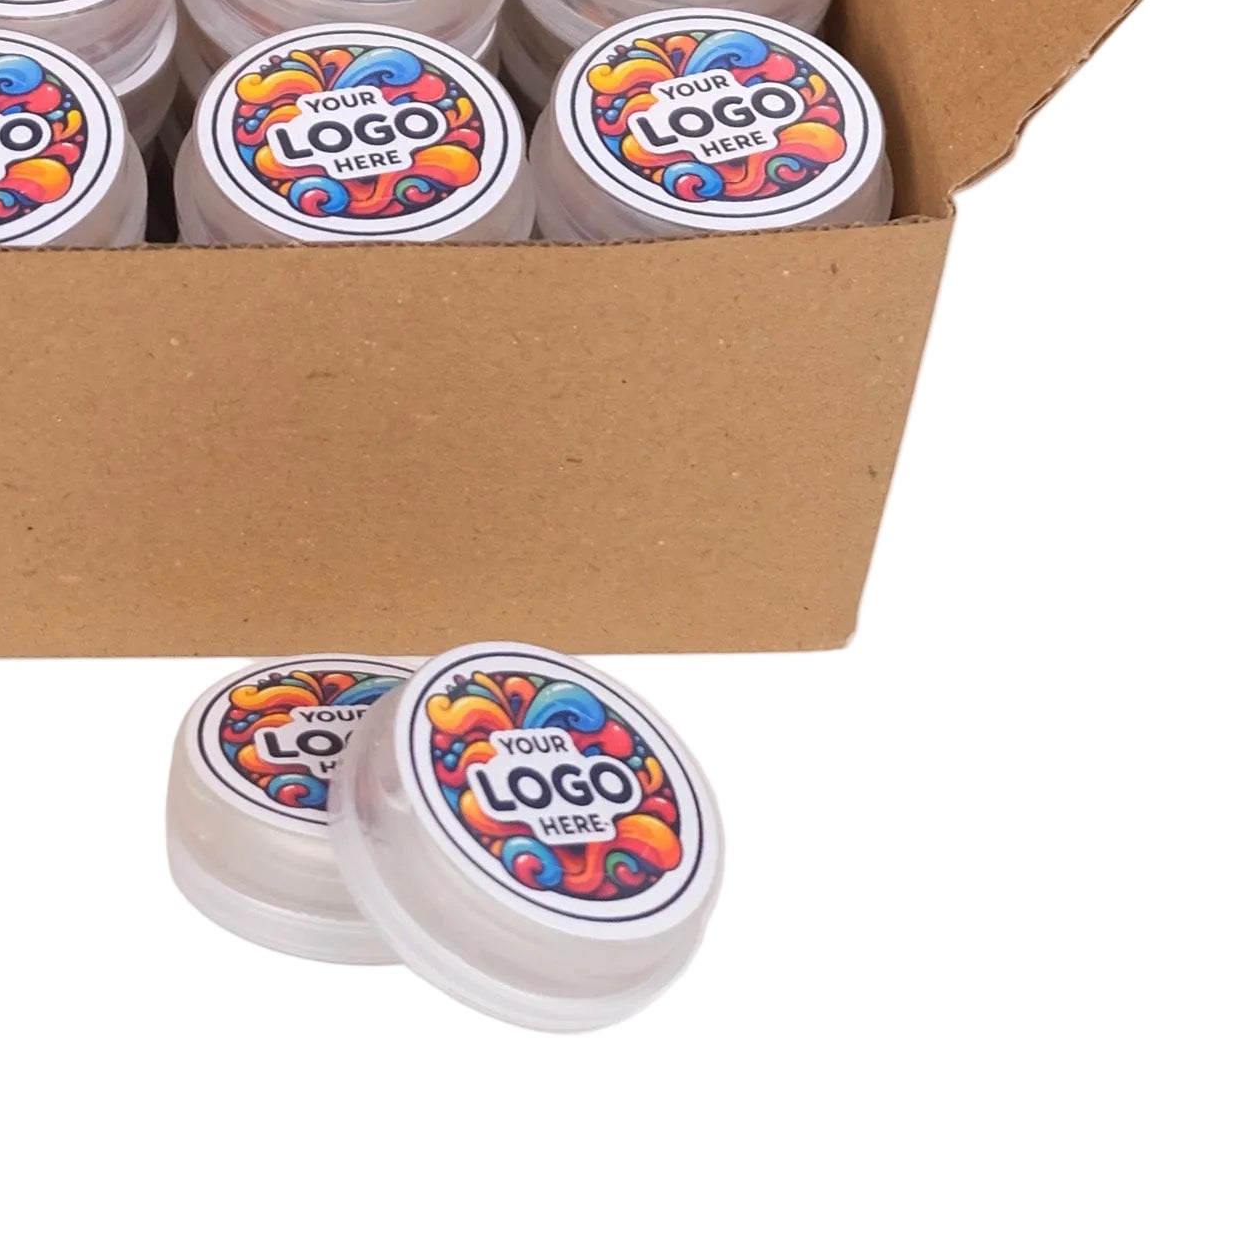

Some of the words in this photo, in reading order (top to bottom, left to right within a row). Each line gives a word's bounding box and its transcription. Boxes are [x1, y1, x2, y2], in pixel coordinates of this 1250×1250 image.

[659, 75, 730, 100] YOUR
[306, 91, 378, 114] YOUR
[636, 87, 796, 148] LOGO
[275, 107, 439, 160] LOGO
[700, 130, 767, 157] HERE
[333, 149, 402, 173] HERE
[263, 729, 354, 758] LO
[499, 735, 568, 755] YOUR
[475, 762, 633, 812] LOGO
